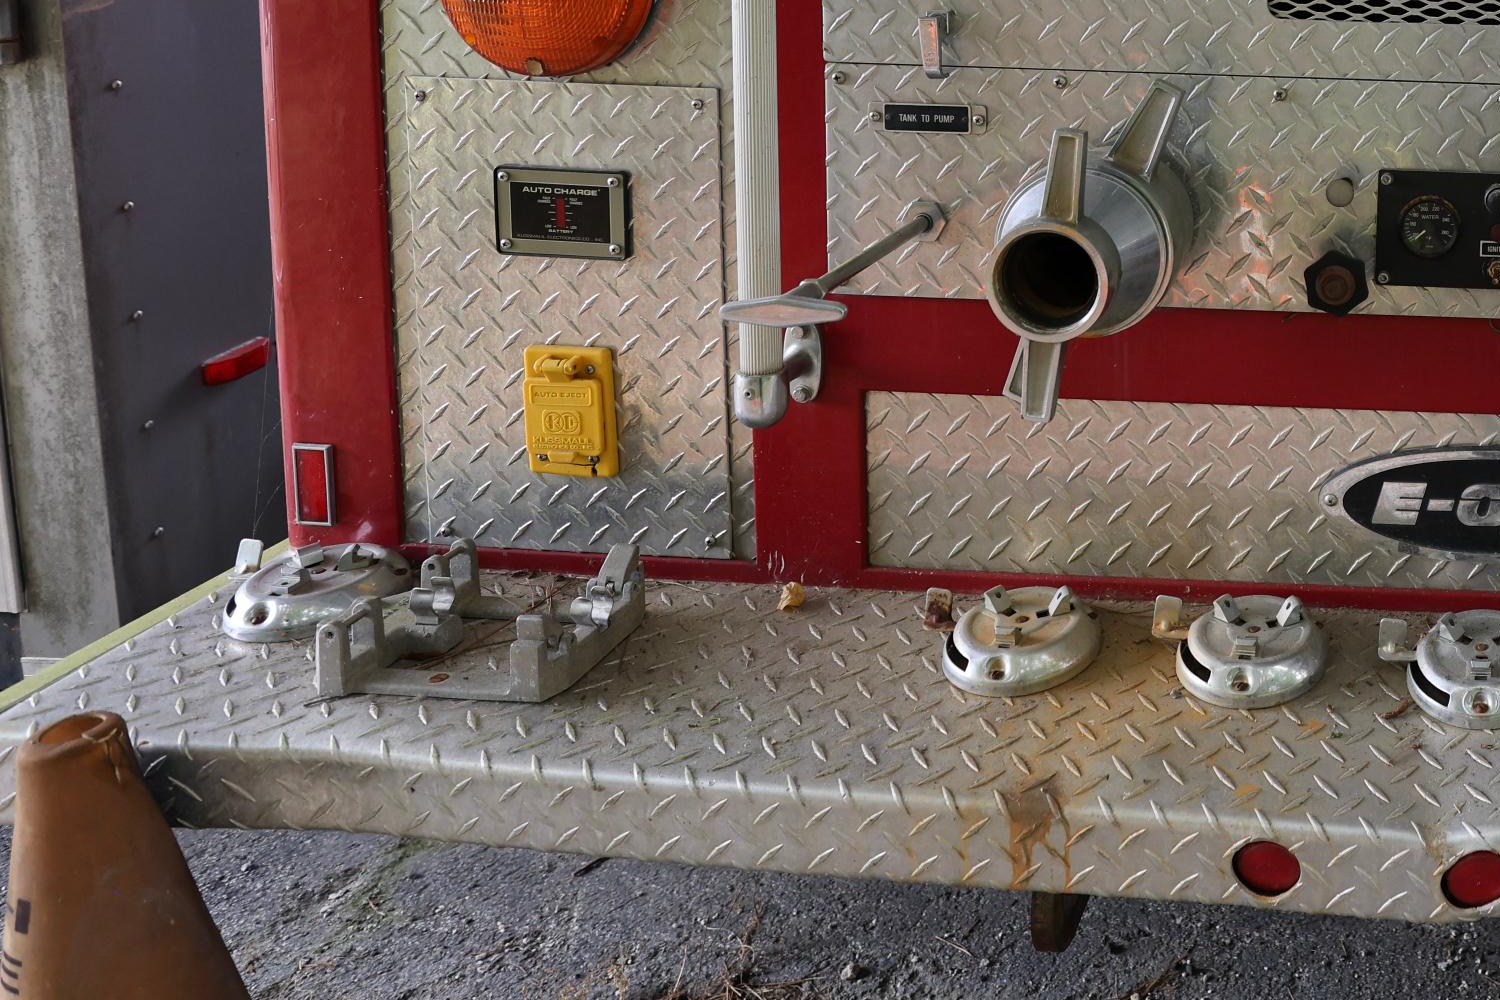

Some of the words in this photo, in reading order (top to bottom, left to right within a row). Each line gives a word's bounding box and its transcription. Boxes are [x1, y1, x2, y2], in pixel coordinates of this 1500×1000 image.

[899, 114, 917, 122] TANK
[934, 115, 954, 123] PUMP
[554, 188, 598, 196] CHARGE
[533, 436, 592, 444] KUSSMAUL
